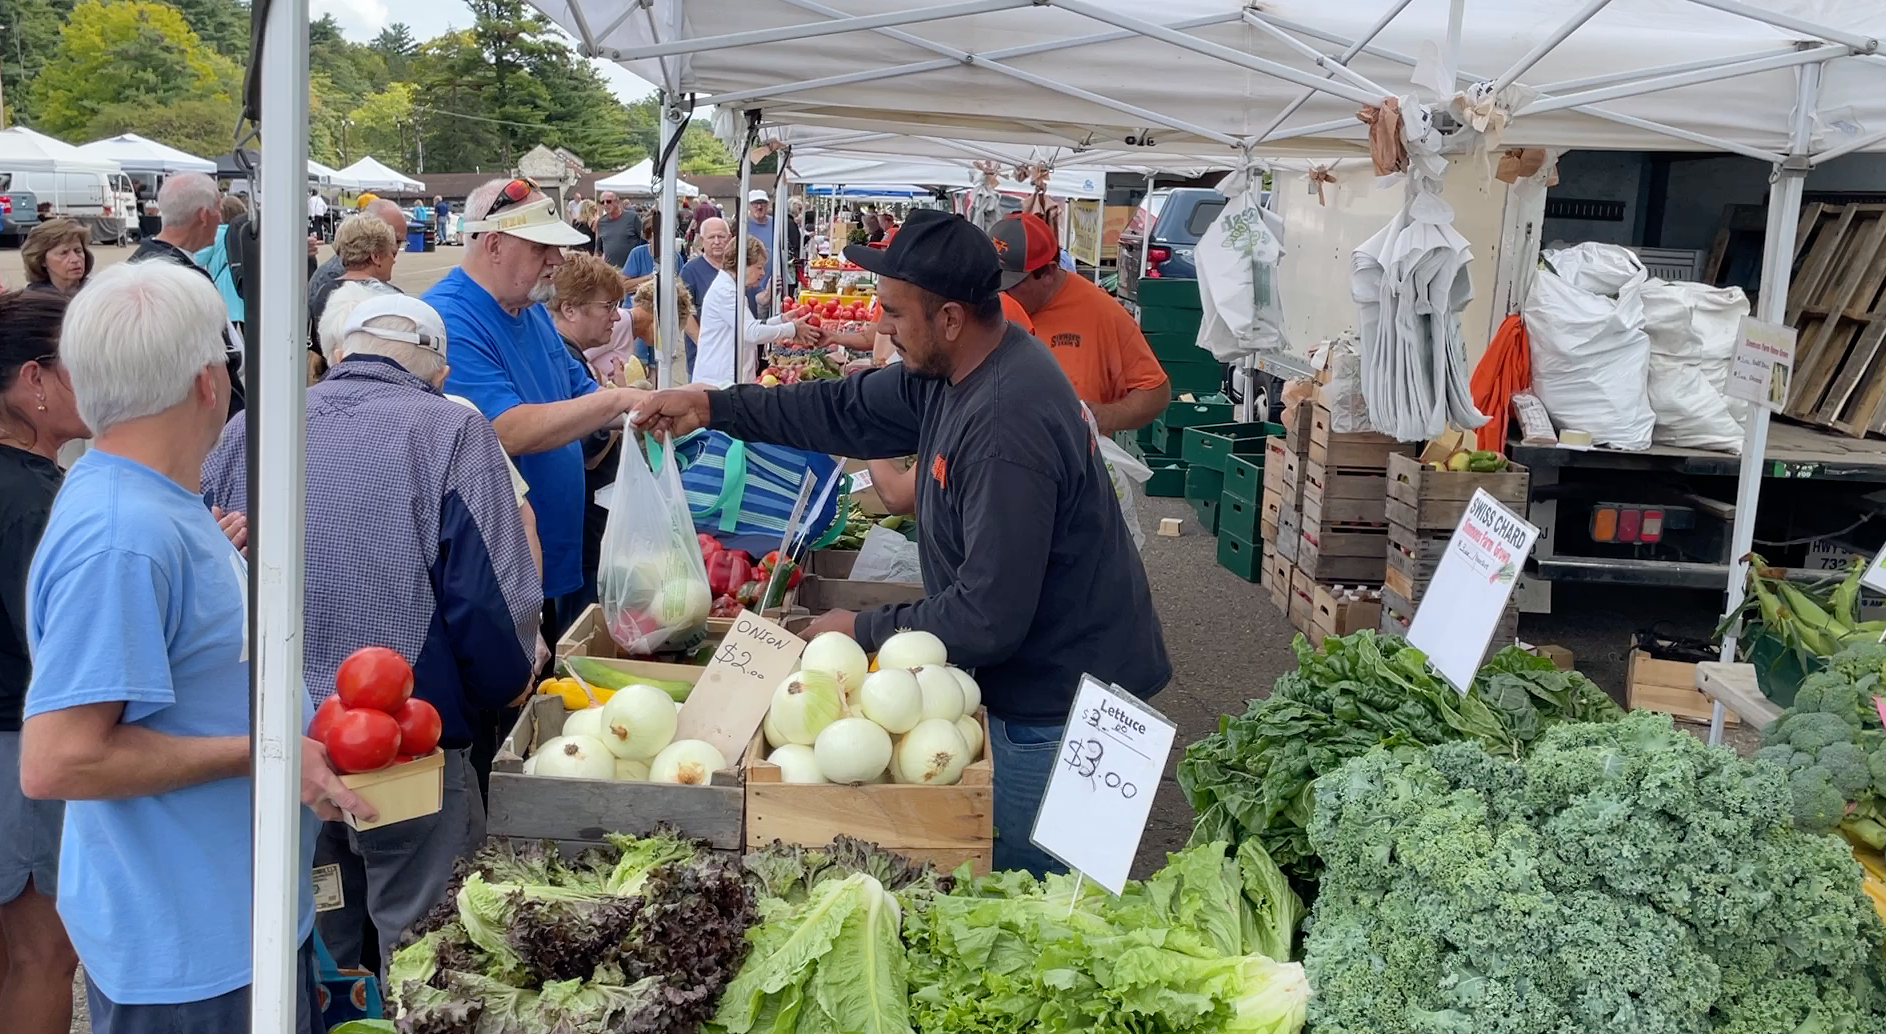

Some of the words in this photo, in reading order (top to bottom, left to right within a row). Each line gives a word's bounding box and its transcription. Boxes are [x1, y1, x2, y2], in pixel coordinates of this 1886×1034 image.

[1470, 497, 1496, 527] SWISS
[1494, 516, 1526, 550] CHARD
[737, 620, 791, 650] ONION
[1100, 699, 1147, 735] Lettuce
